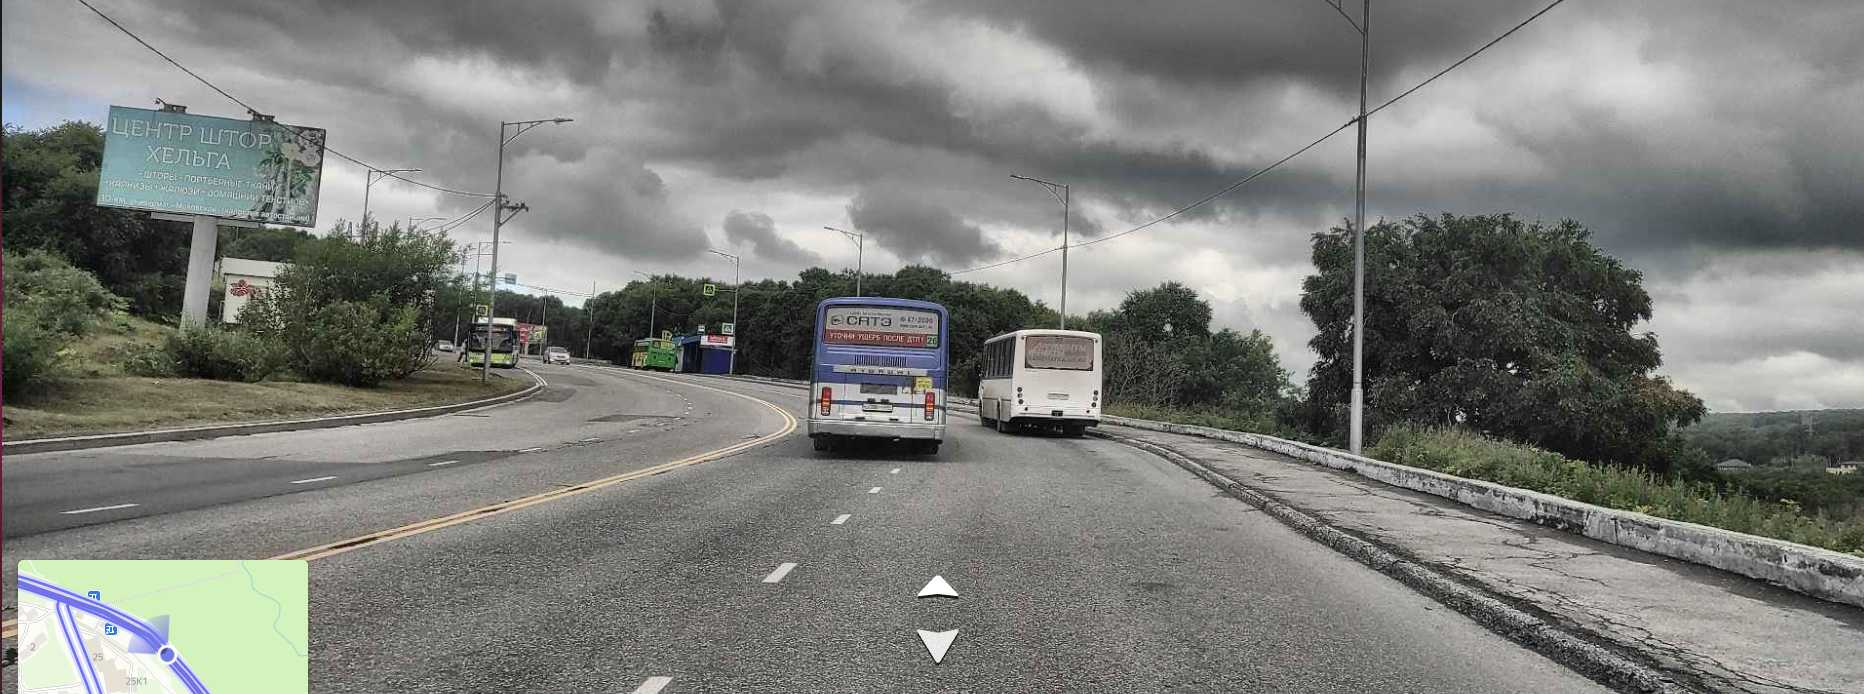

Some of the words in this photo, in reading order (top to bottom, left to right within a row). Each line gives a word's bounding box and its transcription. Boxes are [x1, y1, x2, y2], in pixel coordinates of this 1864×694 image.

[111, 116, 193, 142] ЦЕНТР
[199, 127, 273, 151] ШТОР
[144, 144, 233, 171] ХЕЛЬГА
[830, 332, 855, 341] УТОЧНИ
[859, 333, 881, 342] УЩЕРБ
[883, 335, 905, 343] ПОСЛЕ
